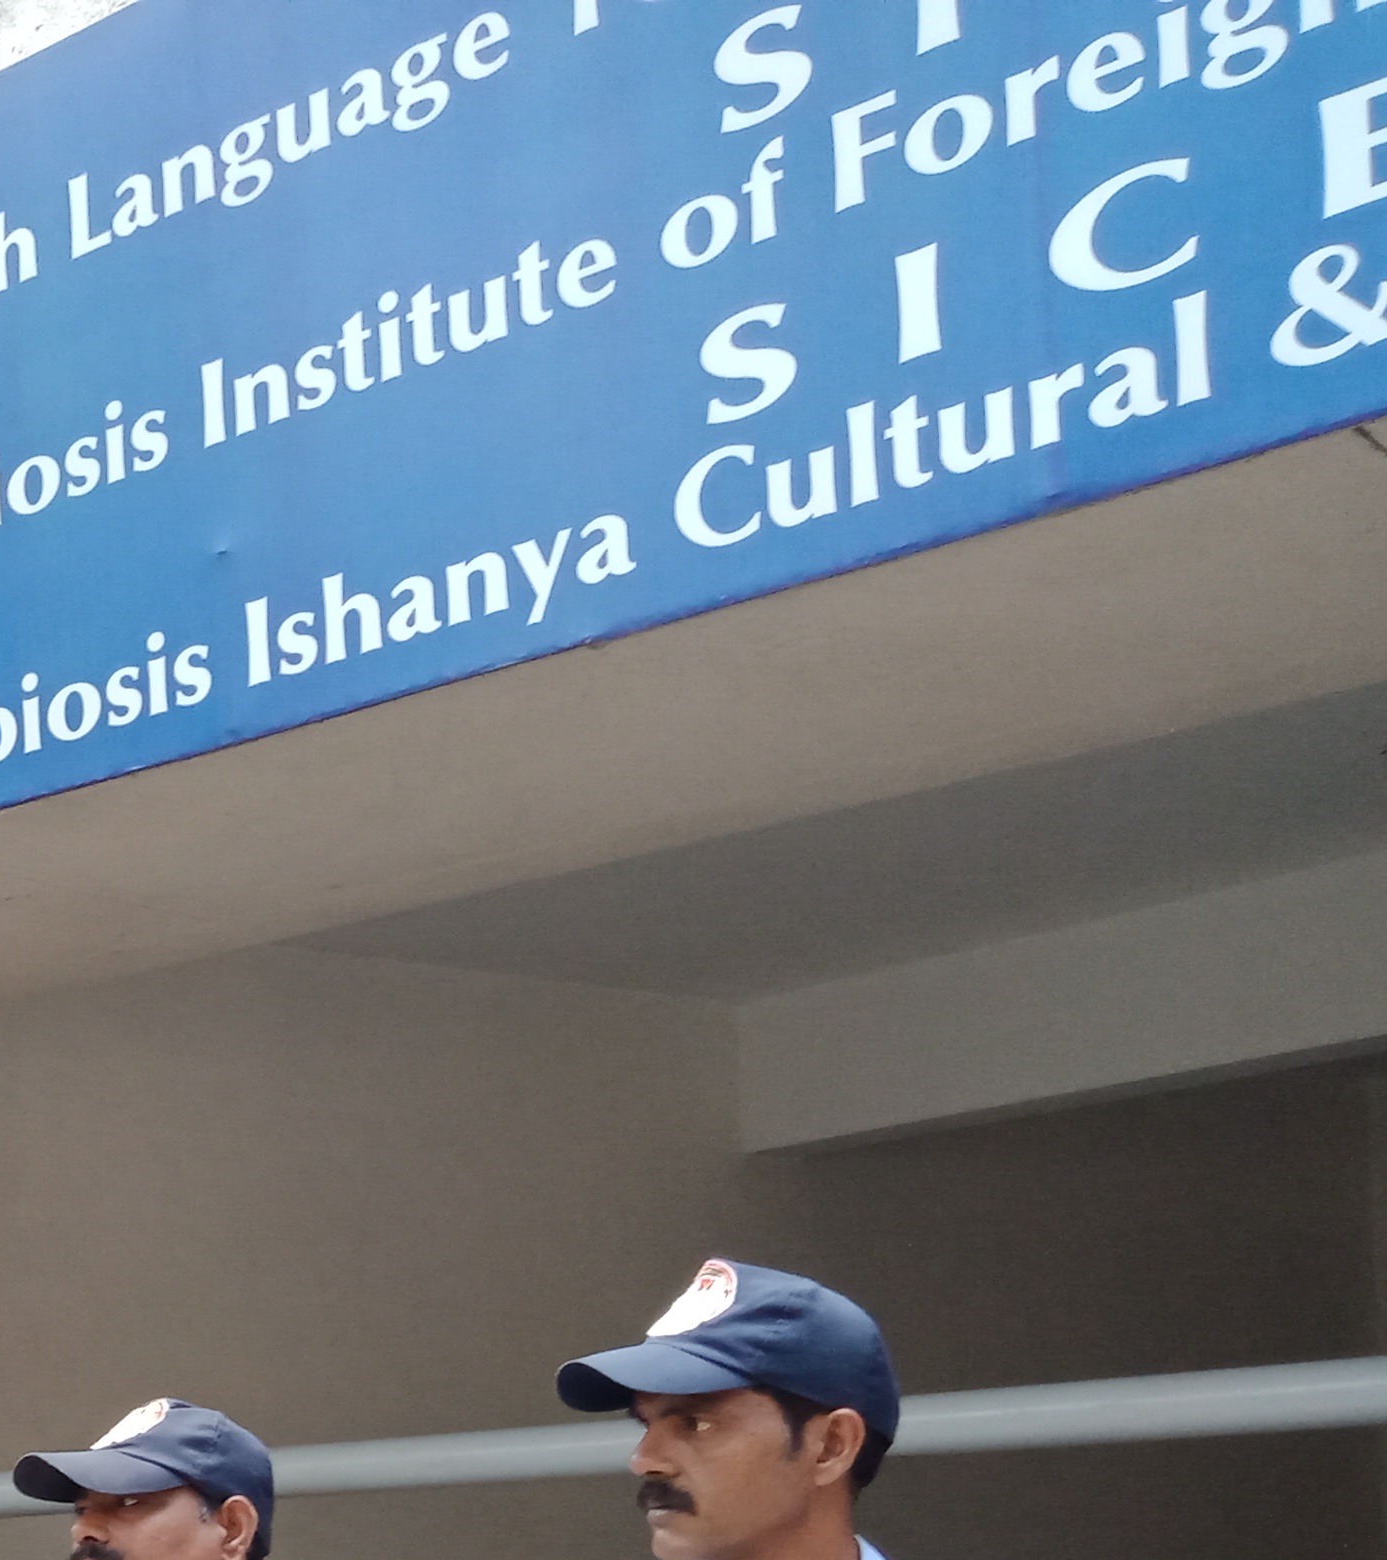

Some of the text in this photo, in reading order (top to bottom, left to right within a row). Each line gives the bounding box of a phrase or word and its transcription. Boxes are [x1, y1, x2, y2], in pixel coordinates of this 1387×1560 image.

[67, 9, 511, 261] Language
[200, 236, 618, 449] Institute
[659, 136, 785, 269] of
[244, 511, 636, 688] Ishanya
[673, 289, 1212, 548] Cultural
[1270, 243, 1387, 368] &
